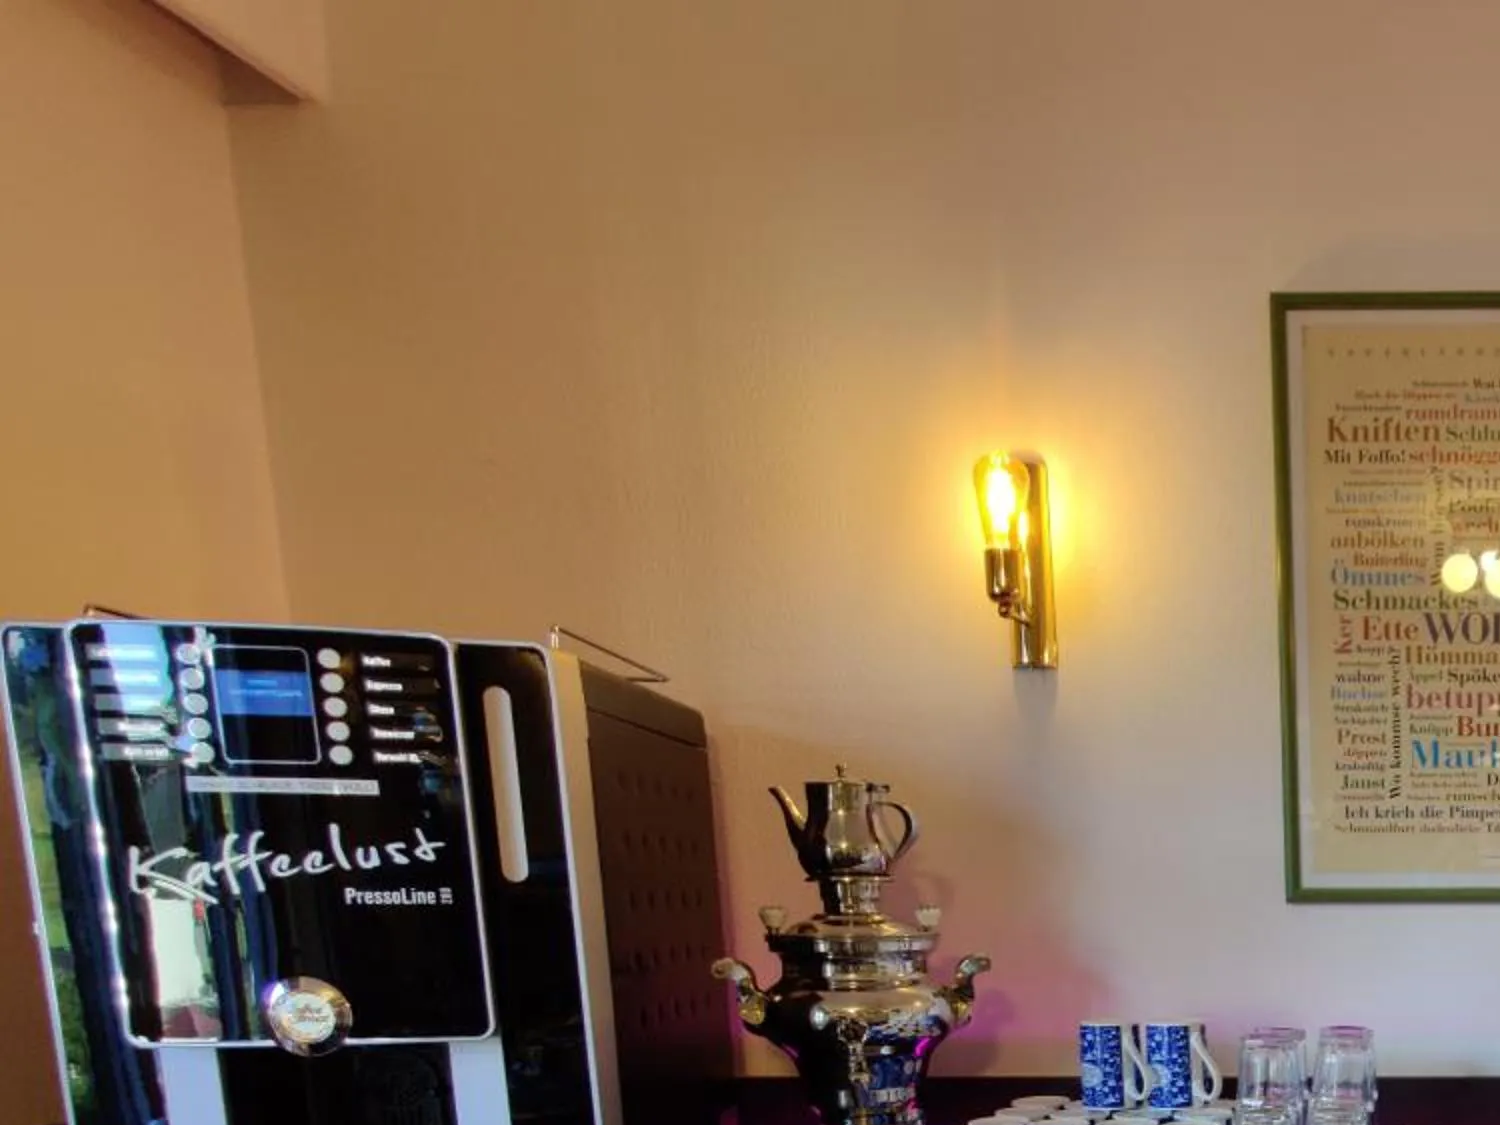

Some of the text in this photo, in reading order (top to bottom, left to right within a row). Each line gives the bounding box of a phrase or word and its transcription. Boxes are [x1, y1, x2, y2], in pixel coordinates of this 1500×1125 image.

[1327, 415, 1441, 443] Kniften
[1324, 449, 1351, 465] Mit
[1330, 529, 1425, 549] anbölken
[1333, 588, 1478, 612] Schmackes
[1361, 614, 1420, 641] Ette
[1345, 805, 1369, 820] Ich
[1419, 805, 1444, 820] die
[128, 822, 446, 905] Kaffeelust
[343, 886, 436, 906] PressoLine
